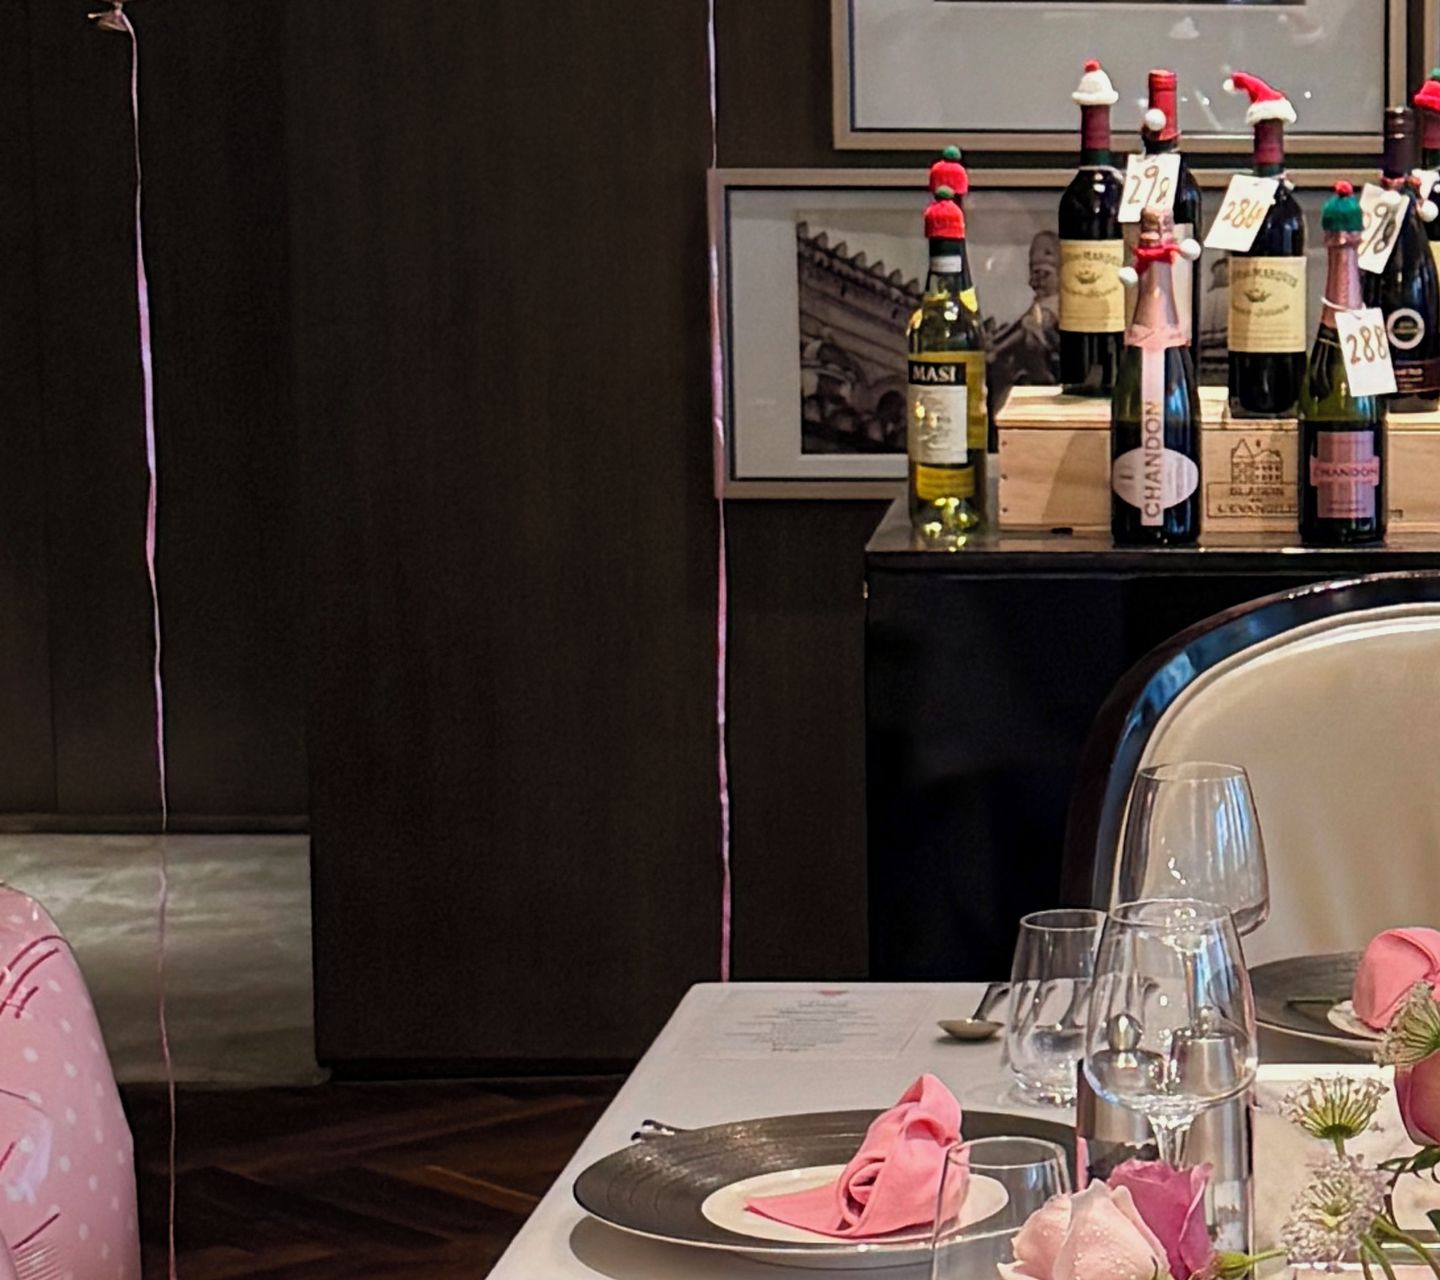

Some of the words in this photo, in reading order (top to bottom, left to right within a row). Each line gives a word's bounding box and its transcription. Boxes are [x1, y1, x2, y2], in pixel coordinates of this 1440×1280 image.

[1346, 324, 1388, 365] 288
[912, 365, 956, 382] MASI
[1144, 401, 1161, 518] CHANDON
[1313, 465, 1378, 478] CHANDON
